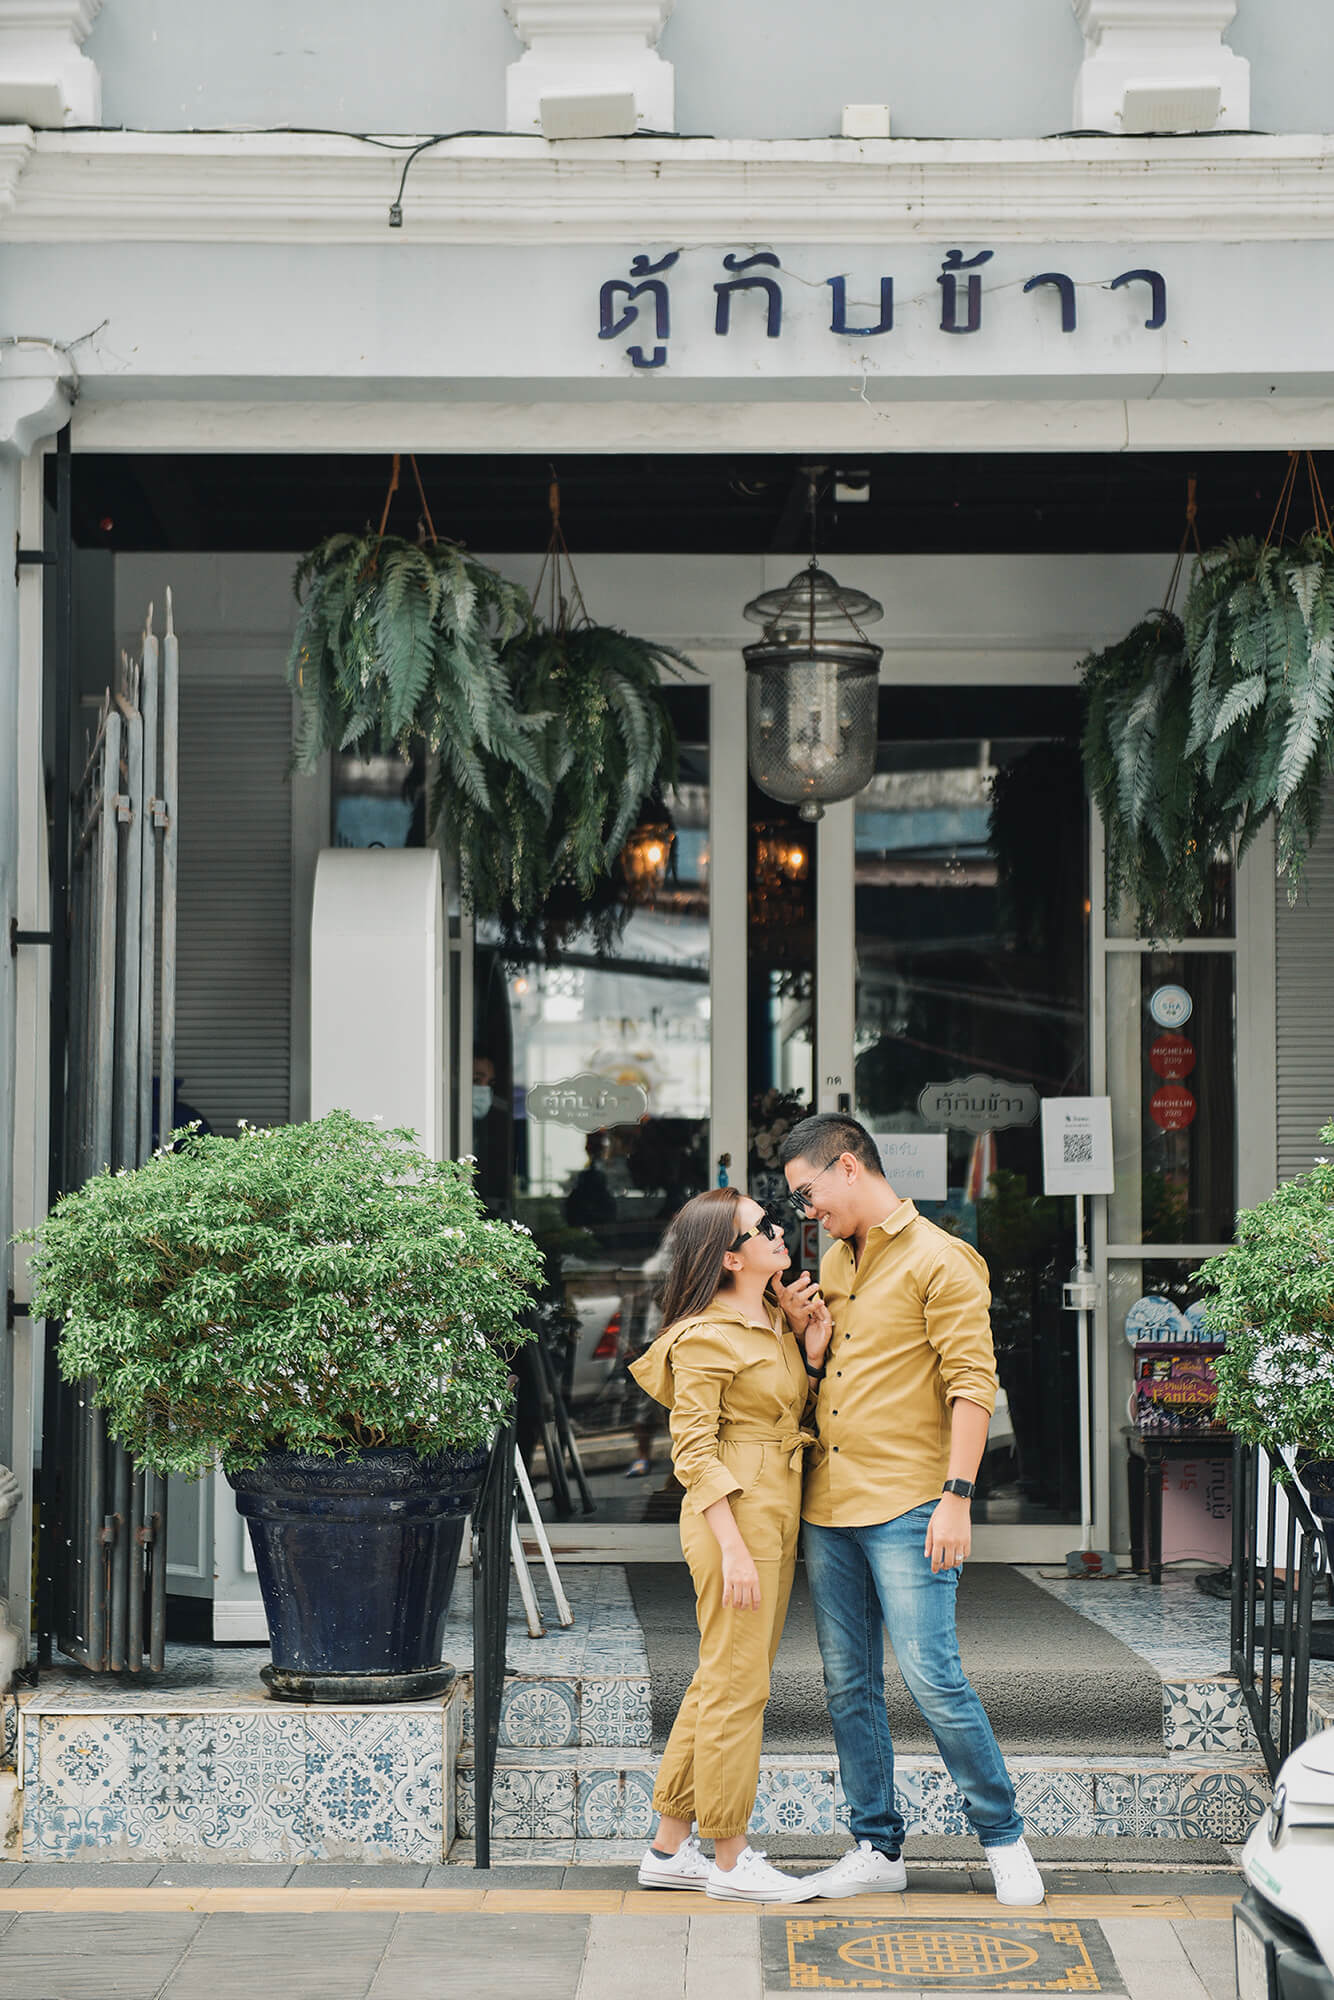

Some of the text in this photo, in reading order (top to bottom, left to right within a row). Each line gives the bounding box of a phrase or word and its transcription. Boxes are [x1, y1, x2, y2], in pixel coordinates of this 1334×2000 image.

[598, 249, 1167, 369] ตู้กับข้าว
[1153, 1048, 1192, 1057] MICHELIN
[935, 1092, 1024, 1117] ตู้กับข้าว
[1153, 1100, 1192, 1108] MICHELIN
[1152, 1388, 1217, 1404] FantaSe
